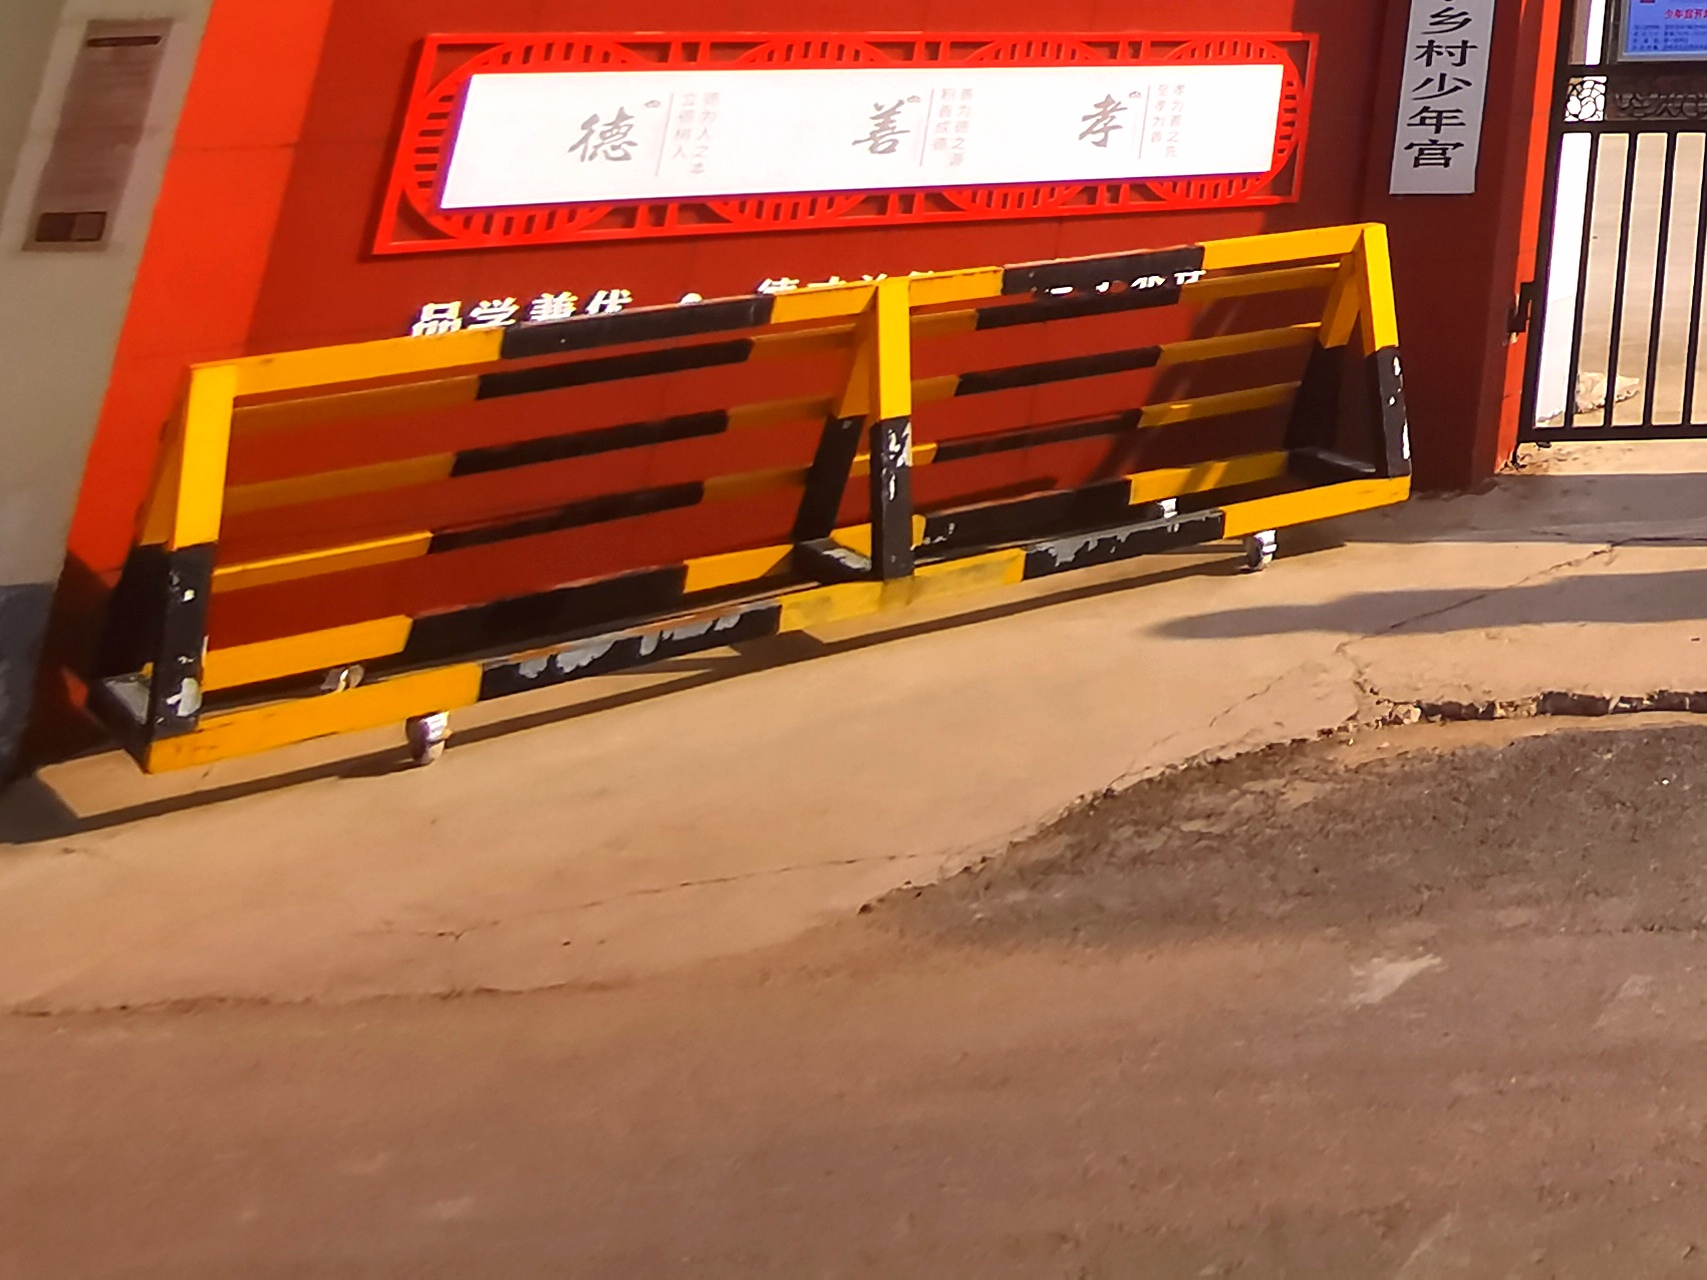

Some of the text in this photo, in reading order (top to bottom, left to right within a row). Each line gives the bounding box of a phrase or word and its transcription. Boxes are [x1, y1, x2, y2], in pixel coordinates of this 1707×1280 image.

[567, 106, 639, 163] 德
[852, 99, 911, 154] 善
[1078, 93, 1128, 148] 孝
